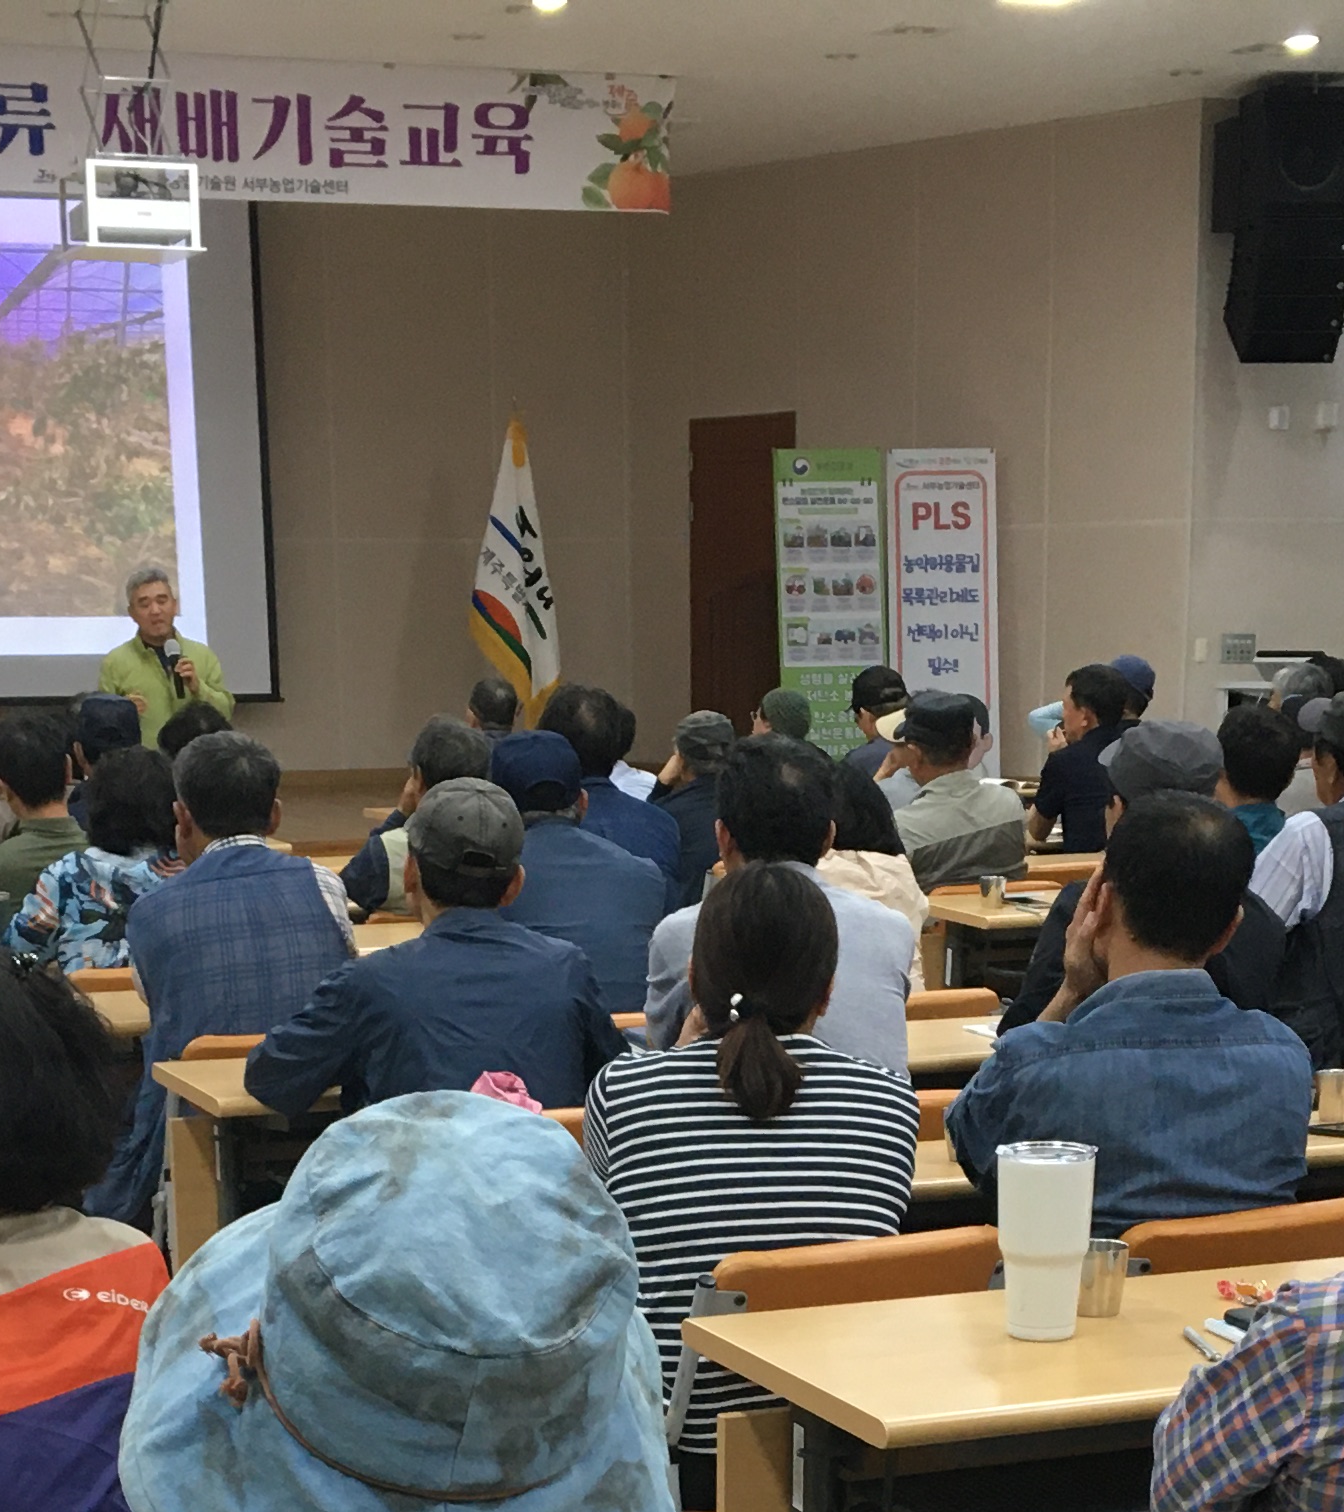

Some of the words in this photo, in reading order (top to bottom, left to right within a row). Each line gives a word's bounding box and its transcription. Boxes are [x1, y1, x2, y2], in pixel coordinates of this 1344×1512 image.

[242, 177, 350, 196] 서부농업기술센터
[911, 501, 972, 531] PLS
[906, 623, 948, 643] 선택이
[950, 622, 979, 642] 아닌
